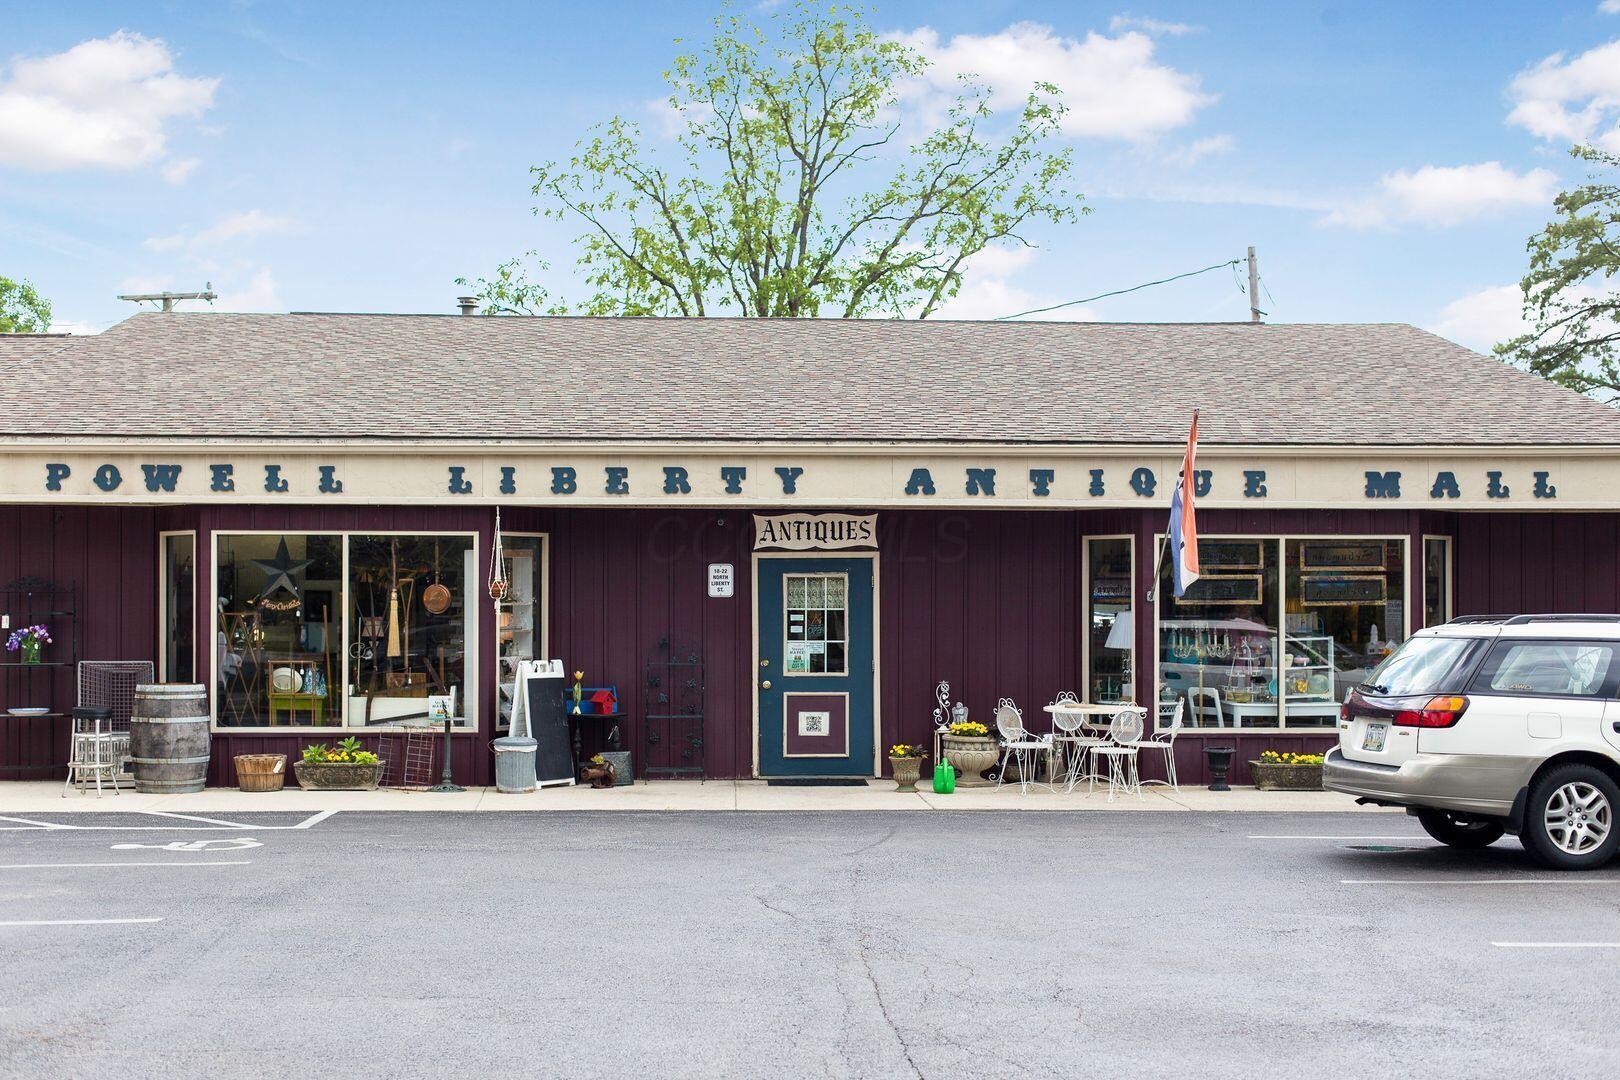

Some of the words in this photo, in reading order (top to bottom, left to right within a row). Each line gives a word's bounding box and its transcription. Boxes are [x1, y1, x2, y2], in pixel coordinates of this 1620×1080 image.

[45, 463, 343, 493] POWELL
[448, 466, 804, 495] LIBERTY
[904, 467, 1268, 498] ANTIQUE
[1364, 471, 1557, 499] MALL
[758, 519, 871, 544] ANTIQUES
